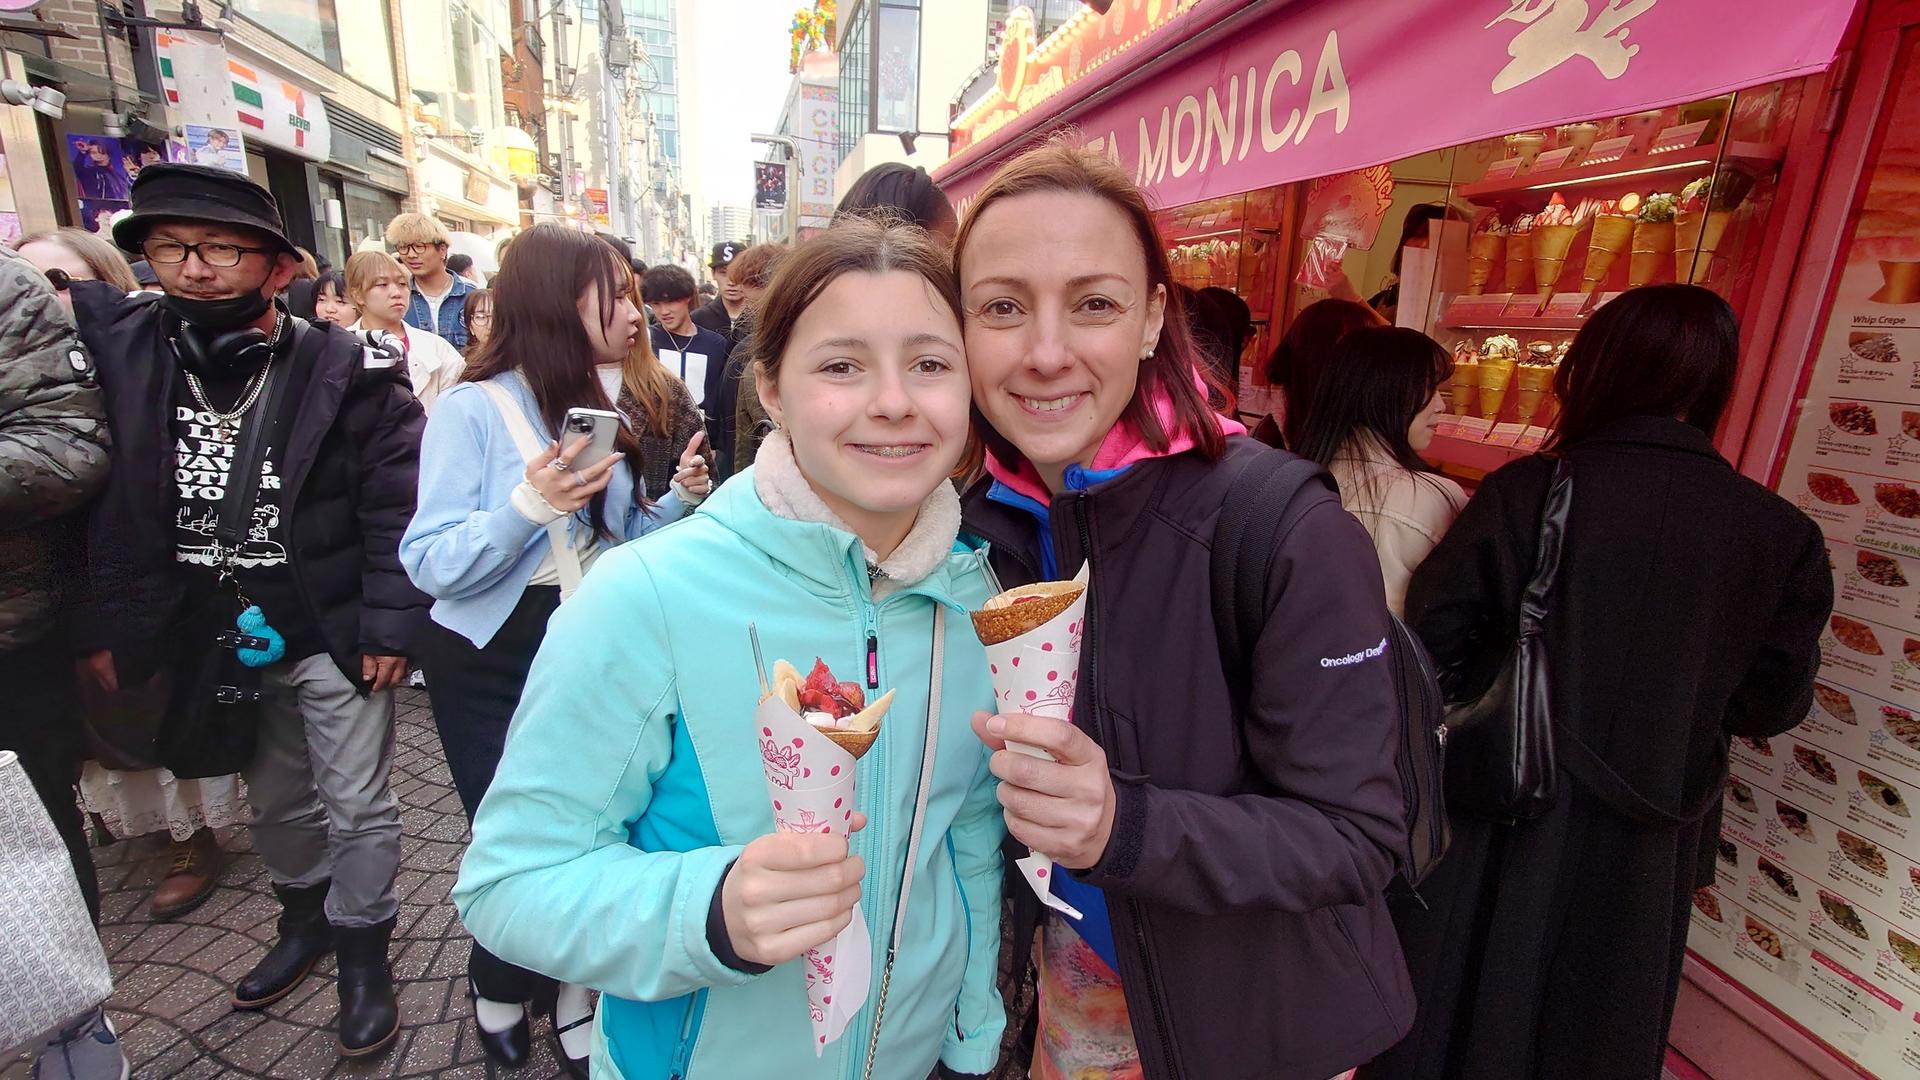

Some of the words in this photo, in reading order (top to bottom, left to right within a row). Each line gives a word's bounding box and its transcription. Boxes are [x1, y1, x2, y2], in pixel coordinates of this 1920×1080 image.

[1135, 30, 1351, 187] MONICA
[1365, 164, 1393, 216] ONICA
[723, 246, 733, 261] S
[1853, 315, 1876, 325] Whip
[1878, 315, 1906, 325] Crepe
[1320, 651, 1365, 668] Oncology
